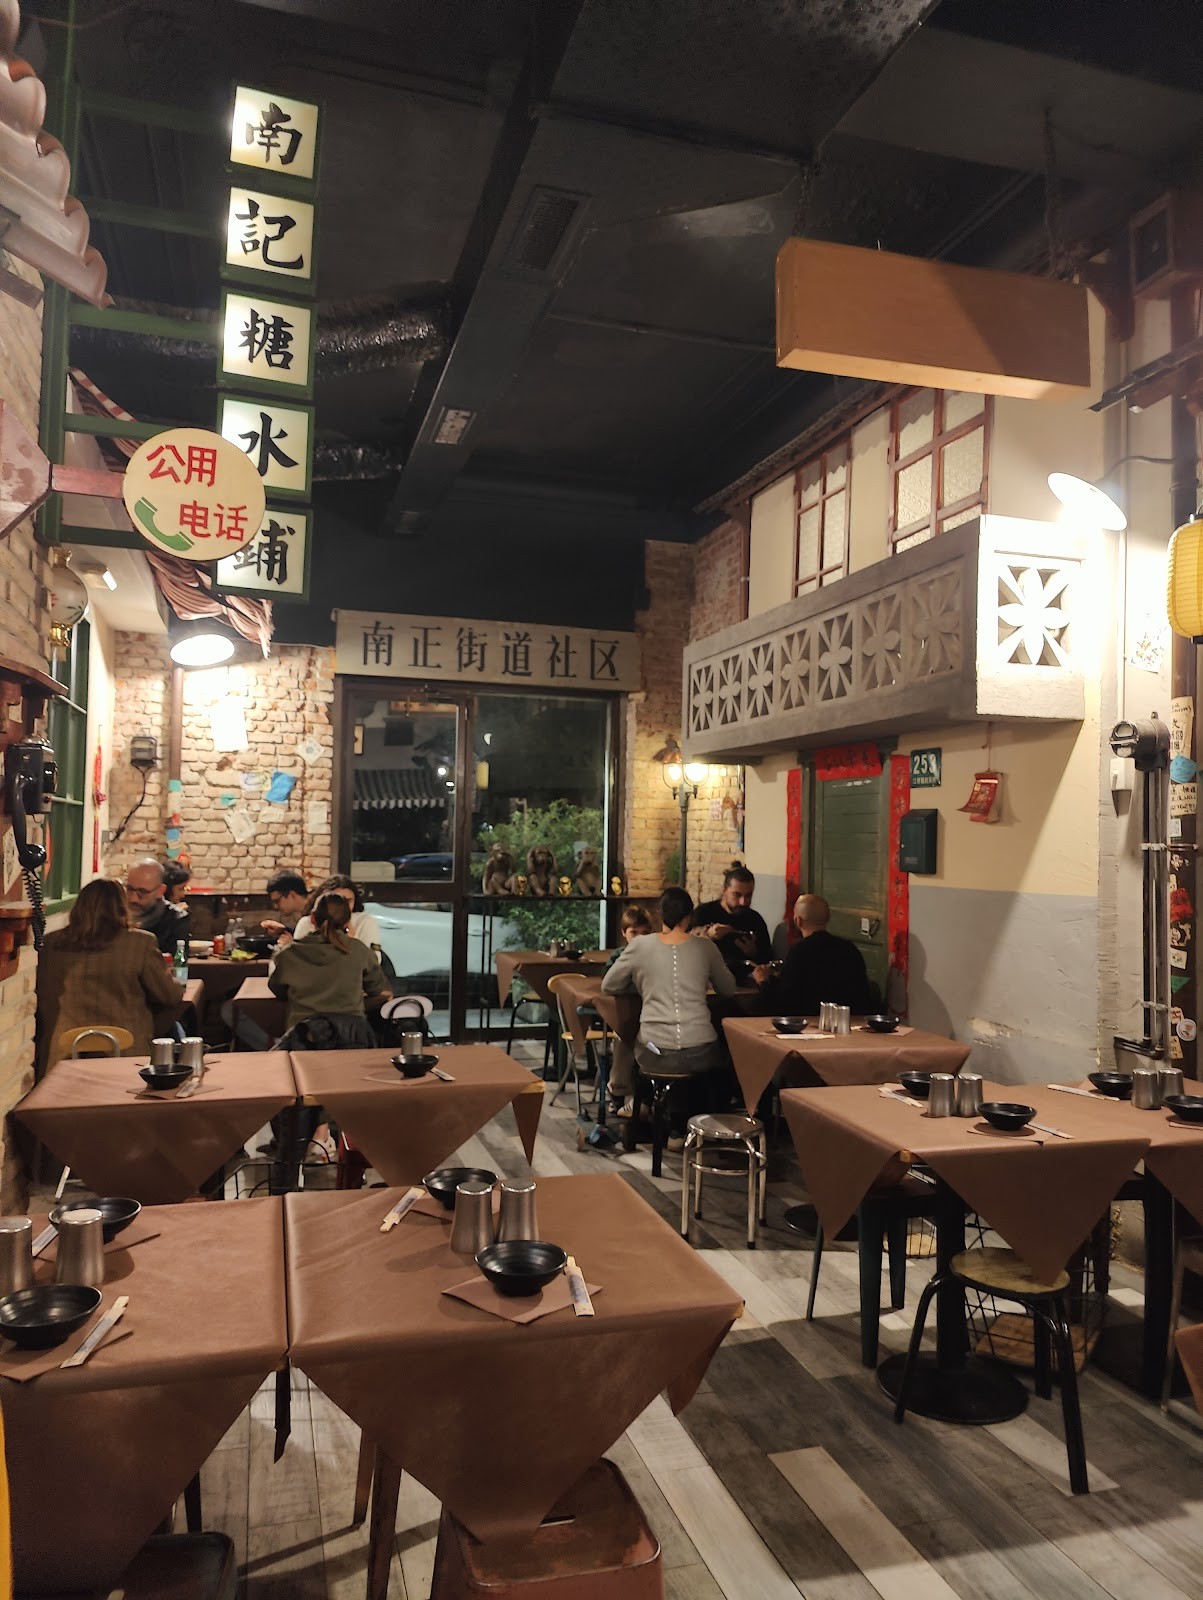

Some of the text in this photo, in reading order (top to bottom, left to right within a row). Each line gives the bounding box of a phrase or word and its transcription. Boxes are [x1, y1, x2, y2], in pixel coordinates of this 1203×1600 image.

[147, 444, 217, 487] 公用
[179, 500, 248, 541] 电话
[360, 621, 620, 681] 南正街道社区
